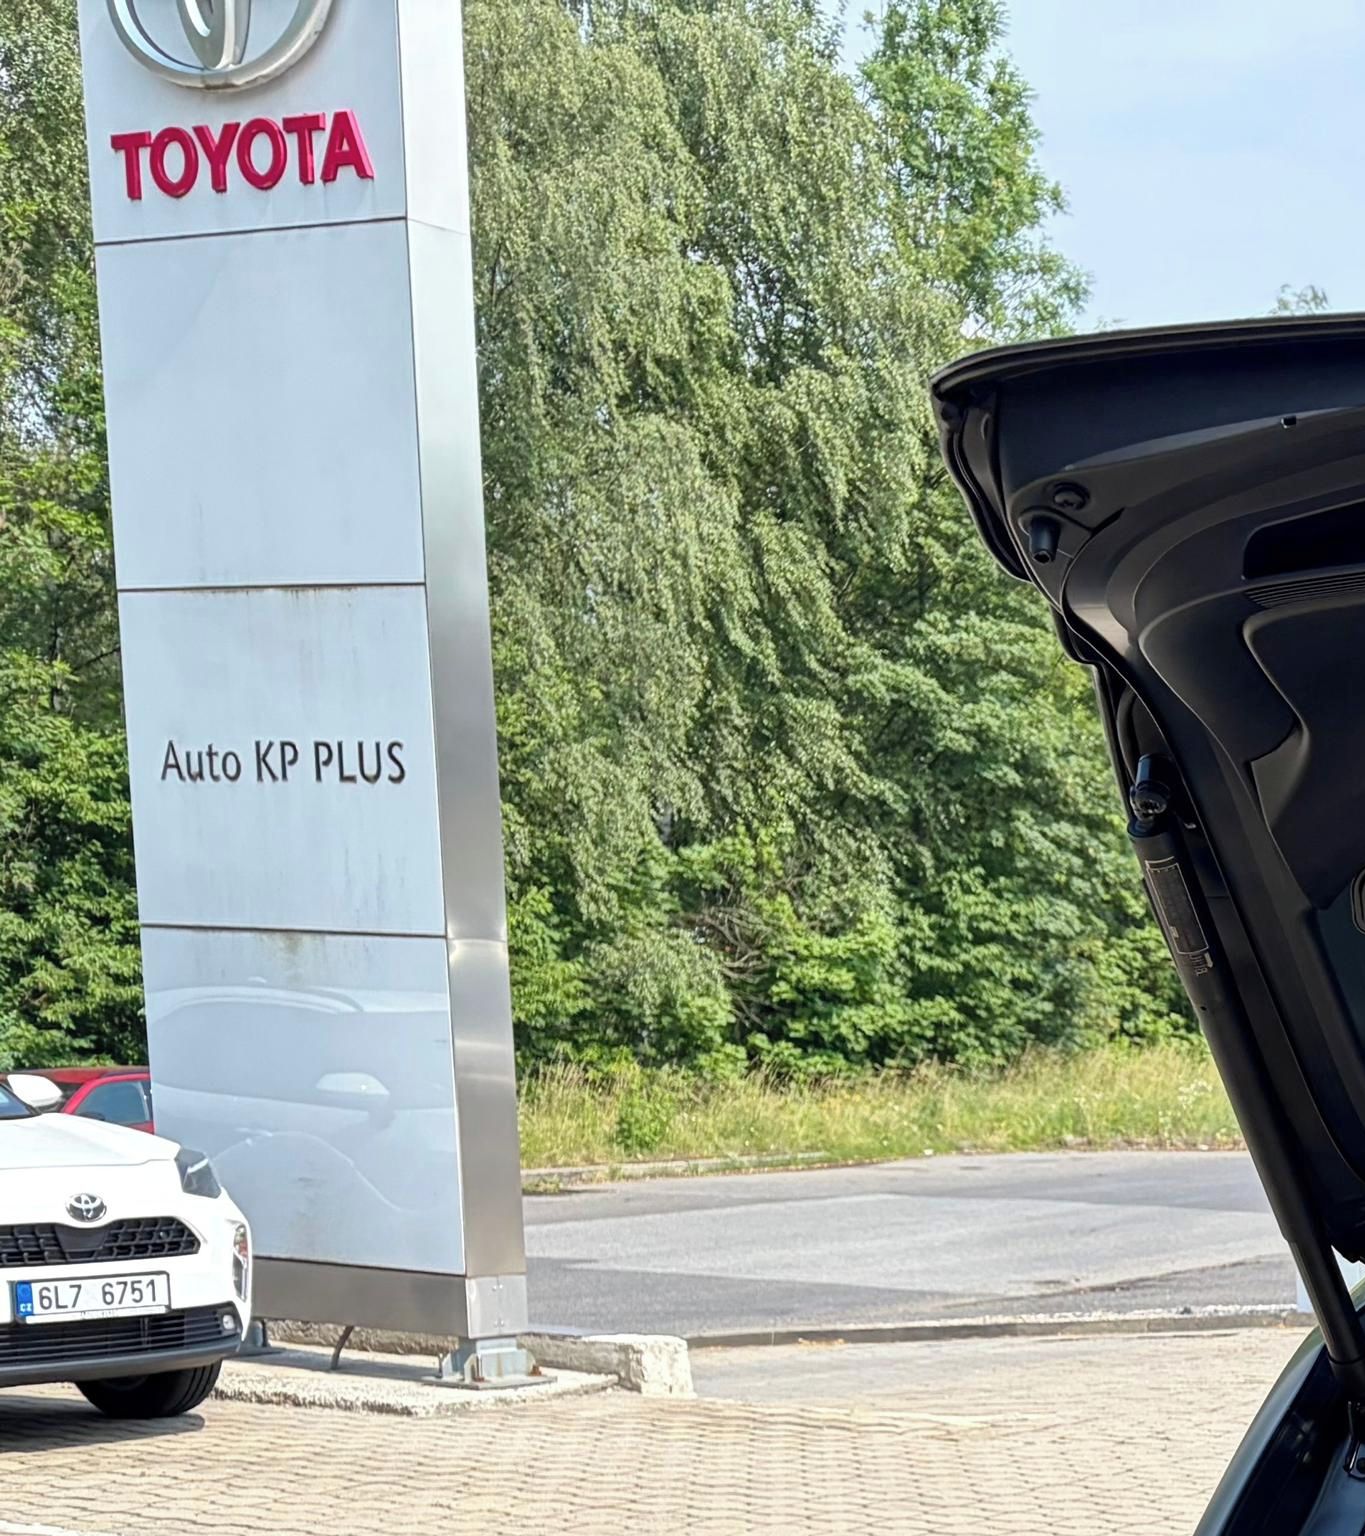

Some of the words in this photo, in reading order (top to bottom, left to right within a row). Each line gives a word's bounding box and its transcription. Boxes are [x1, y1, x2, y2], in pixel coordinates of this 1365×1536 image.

[110, 110, 375, 201] TOYOTA
[161, 740, 241, 783] Auto
[255, 740, 299, 783] KP
[314, 740, 406, 785] PLUS
[38, 1284, 82, 1310] 6L7
[101, 1279, 156, 1305] 6751
